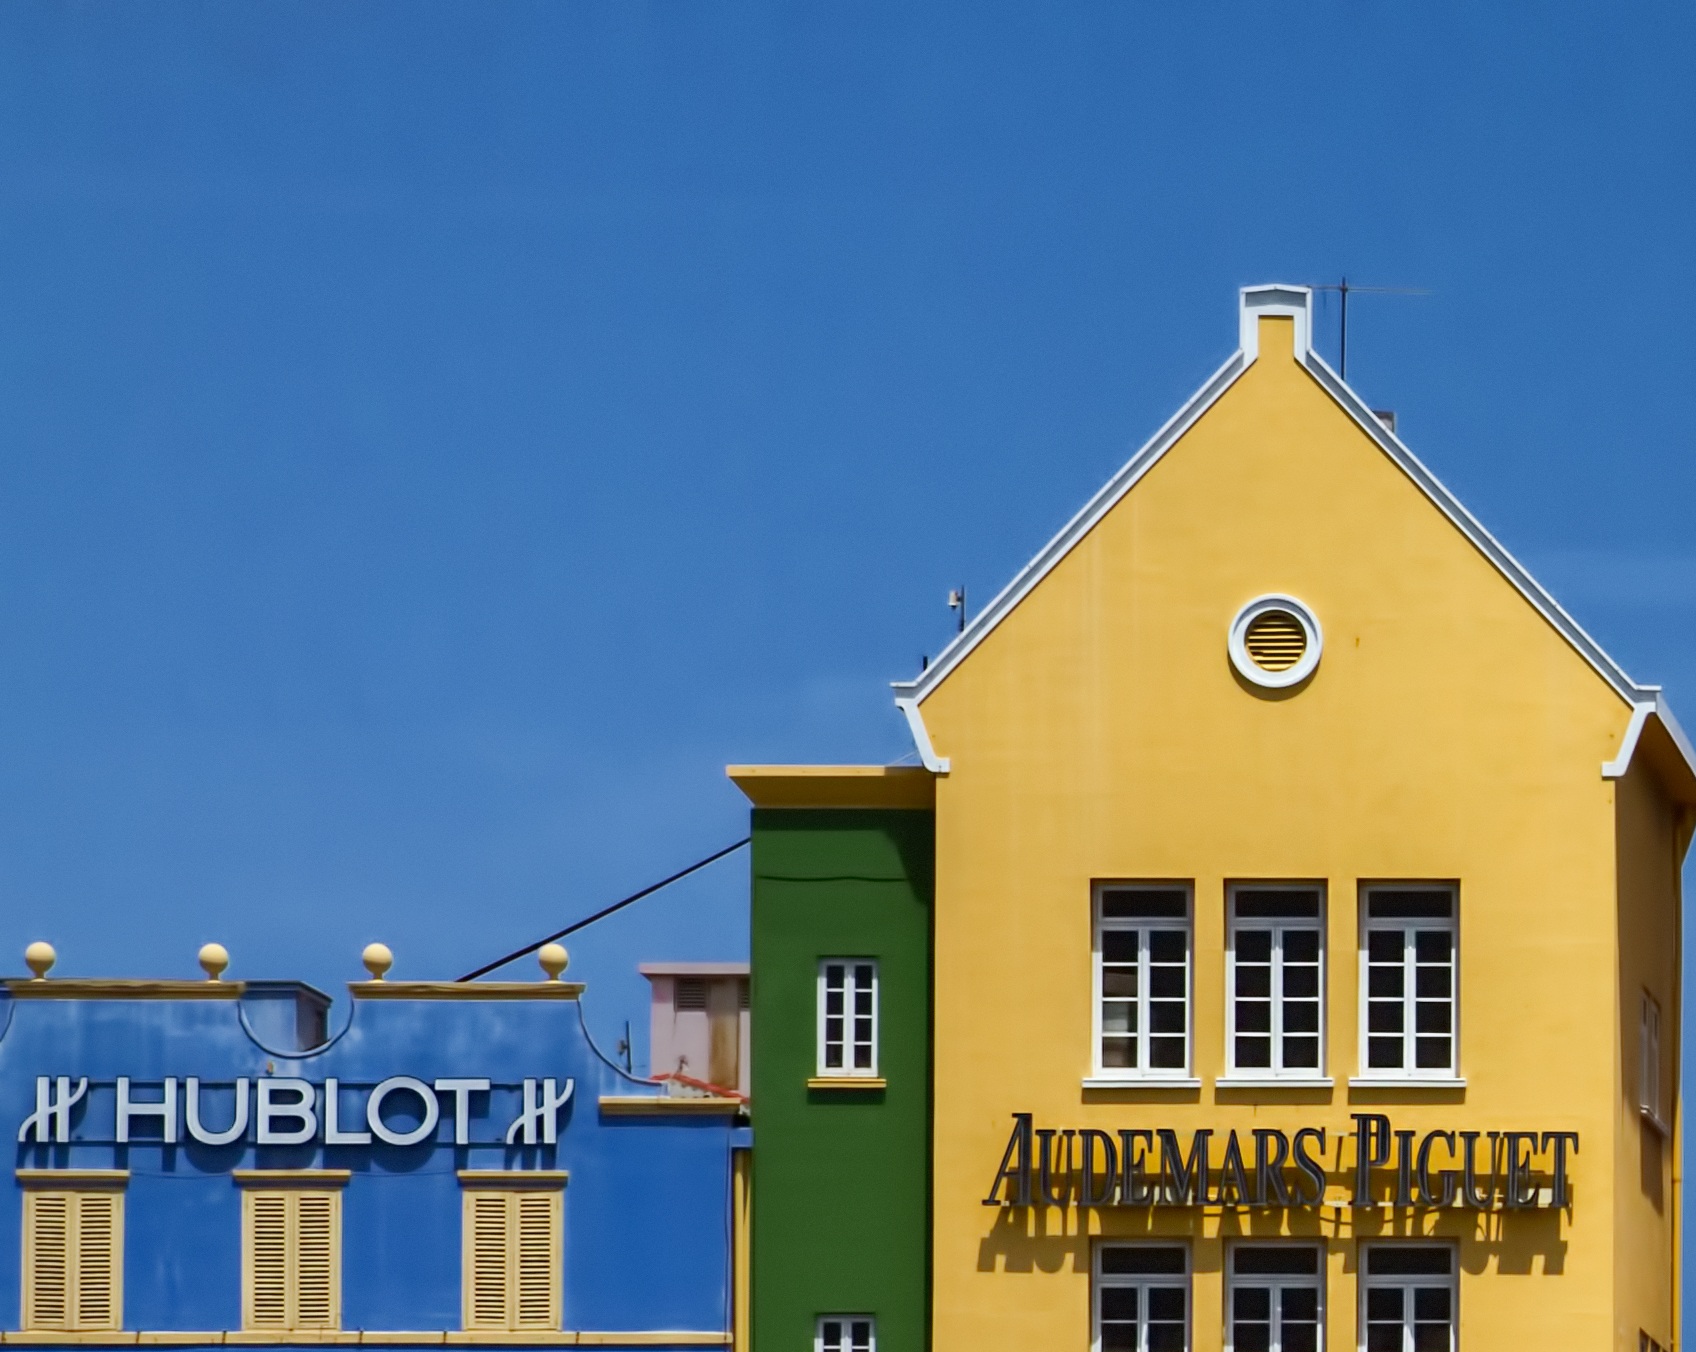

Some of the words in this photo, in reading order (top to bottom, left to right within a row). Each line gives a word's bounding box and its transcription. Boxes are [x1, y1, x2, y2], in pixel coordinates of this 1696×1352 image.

[116, 1076, 490, 1145] HUBLOT
[982, 1112, 1327, 1206] AUDEMARS
[1350, 1112, 1579, 1209] PIGUET
